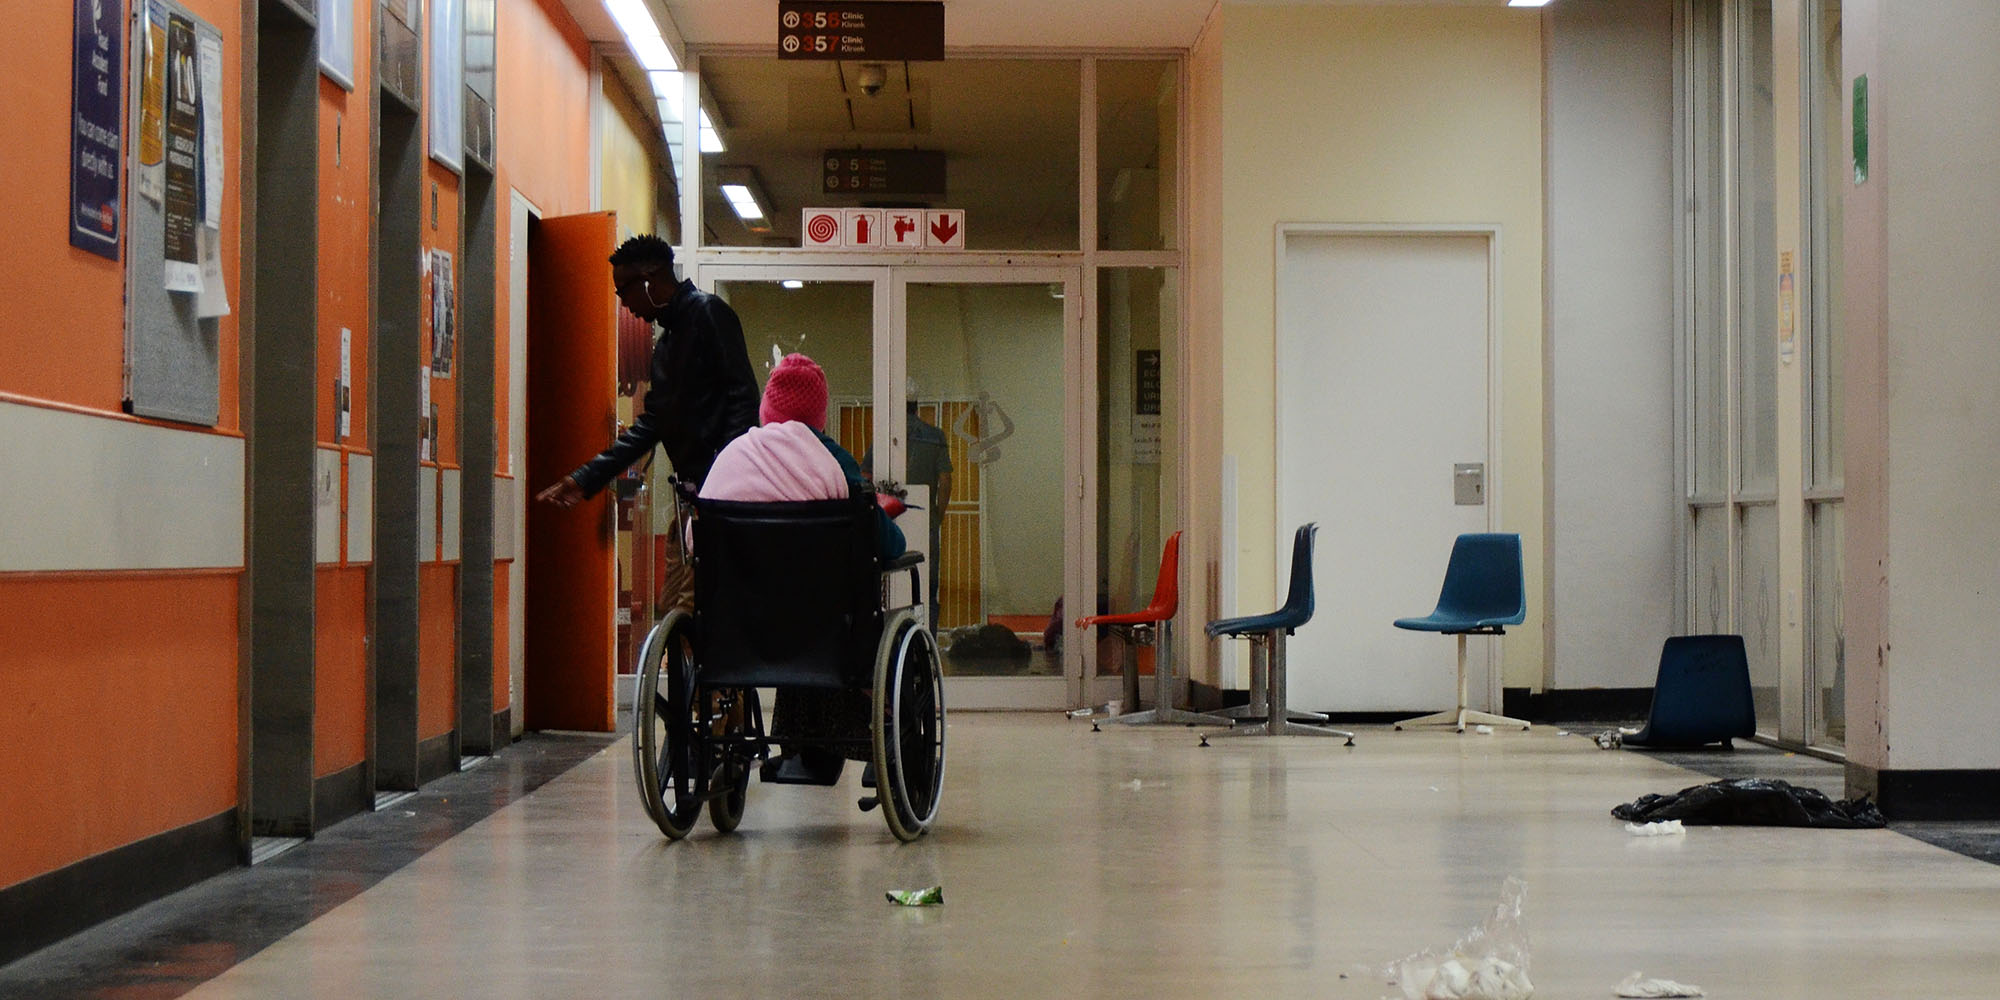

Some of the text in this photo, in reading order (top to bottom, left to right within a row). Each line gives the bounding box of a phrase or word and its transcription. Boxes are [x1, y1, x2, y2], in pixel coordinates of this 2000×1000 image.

[802, 12, 840, 28] 356
[802, 35, 840, 52] 357
[842, 35, 864, 44] Clinic
